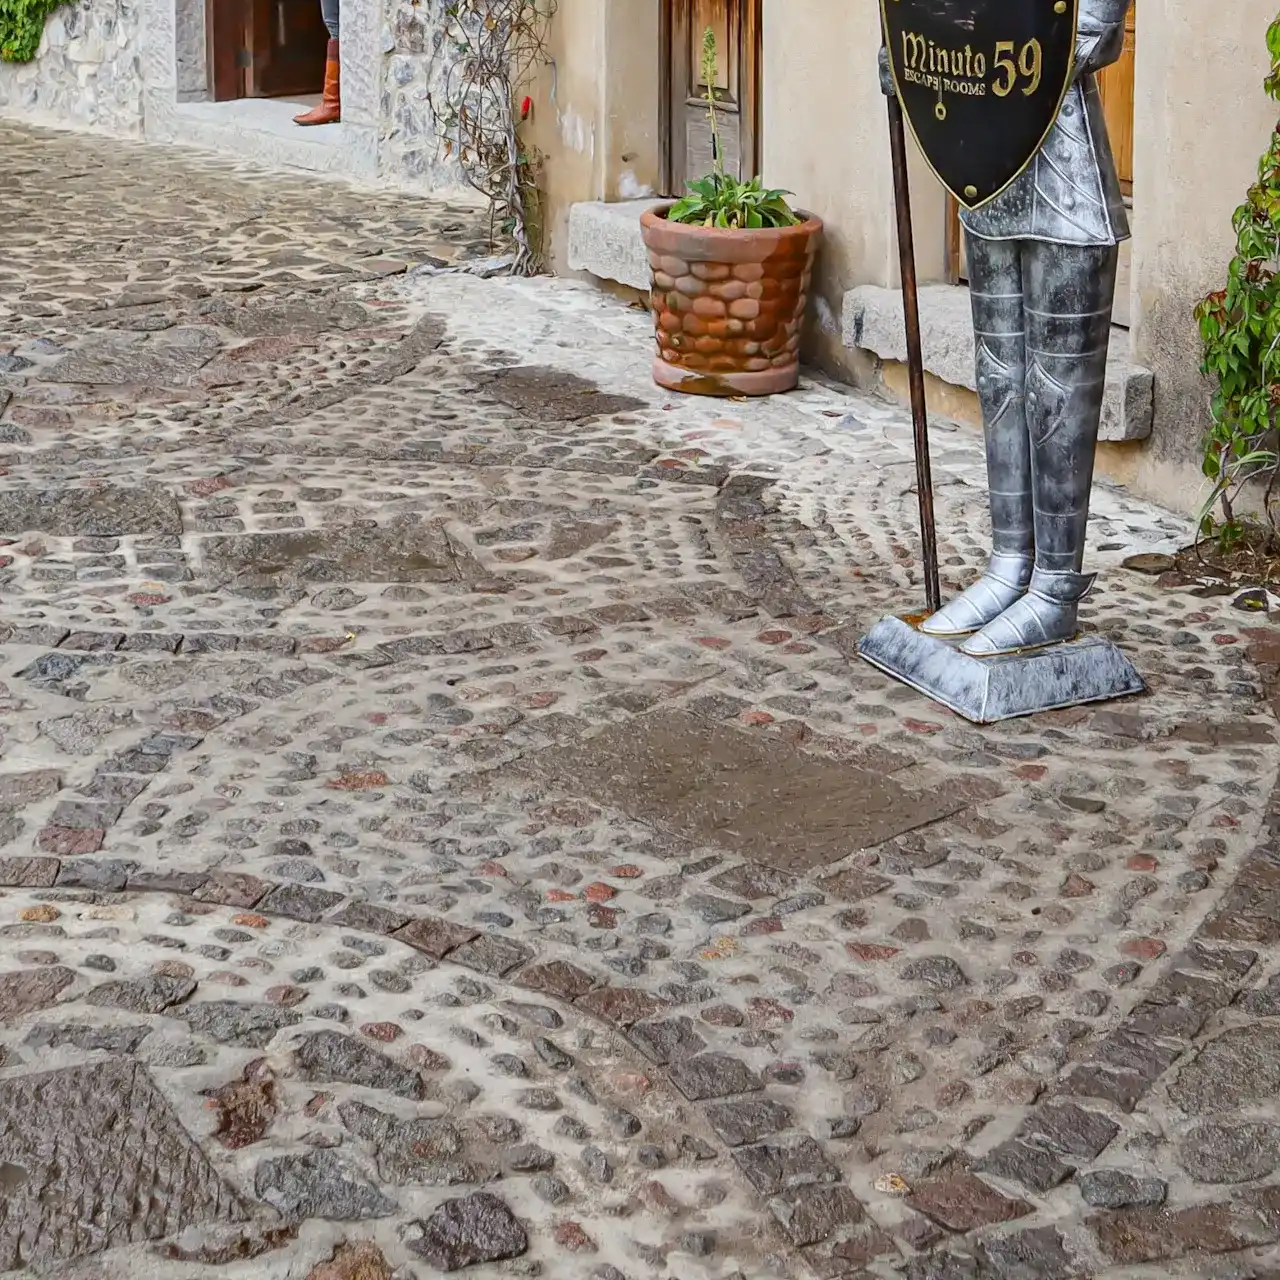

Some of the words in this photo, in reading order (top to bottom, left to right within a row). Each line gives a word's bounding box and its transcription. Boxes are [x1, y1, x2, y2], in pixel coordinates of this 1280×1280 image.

[901, 30, 986, 79] Minuto
[991, 36, 1042, 97] 59
[904, 67, 939, 91] ESCAPE
[943, 78, 986, 96] ROOMS
